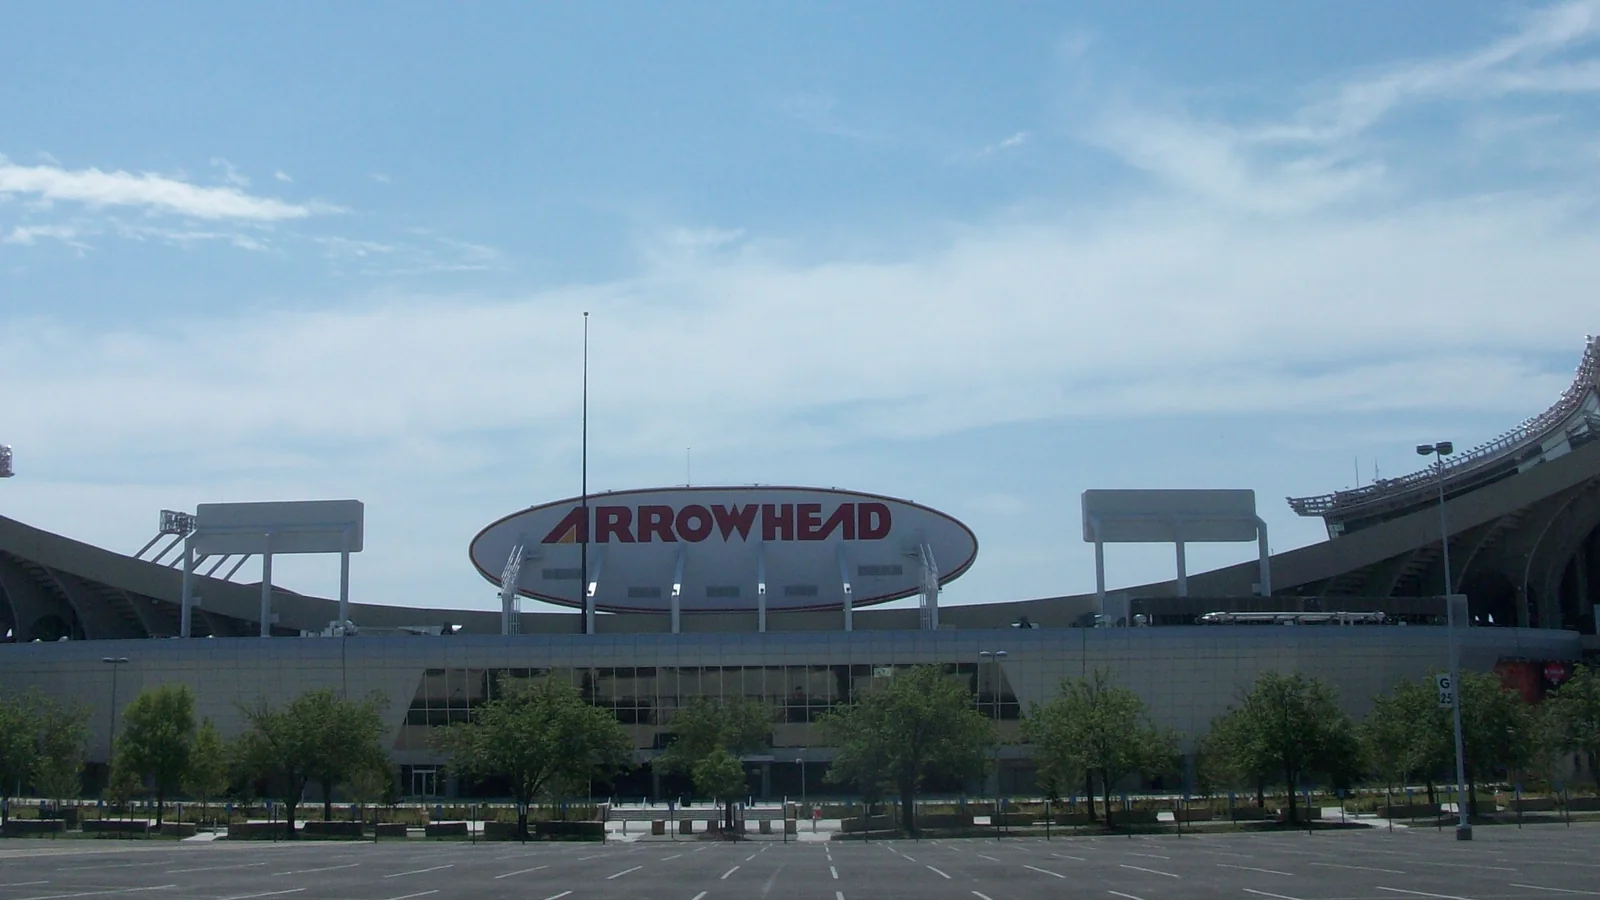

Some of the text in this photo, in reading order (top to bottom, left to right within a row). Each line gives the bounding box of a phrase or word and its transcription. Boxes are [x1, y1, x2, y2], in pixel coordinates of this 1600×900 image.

[541, 503, 891, 543] ARROWHEAD
[1440, 678, 1450, 689] G
[1440, 693, 1452, 704] 25
